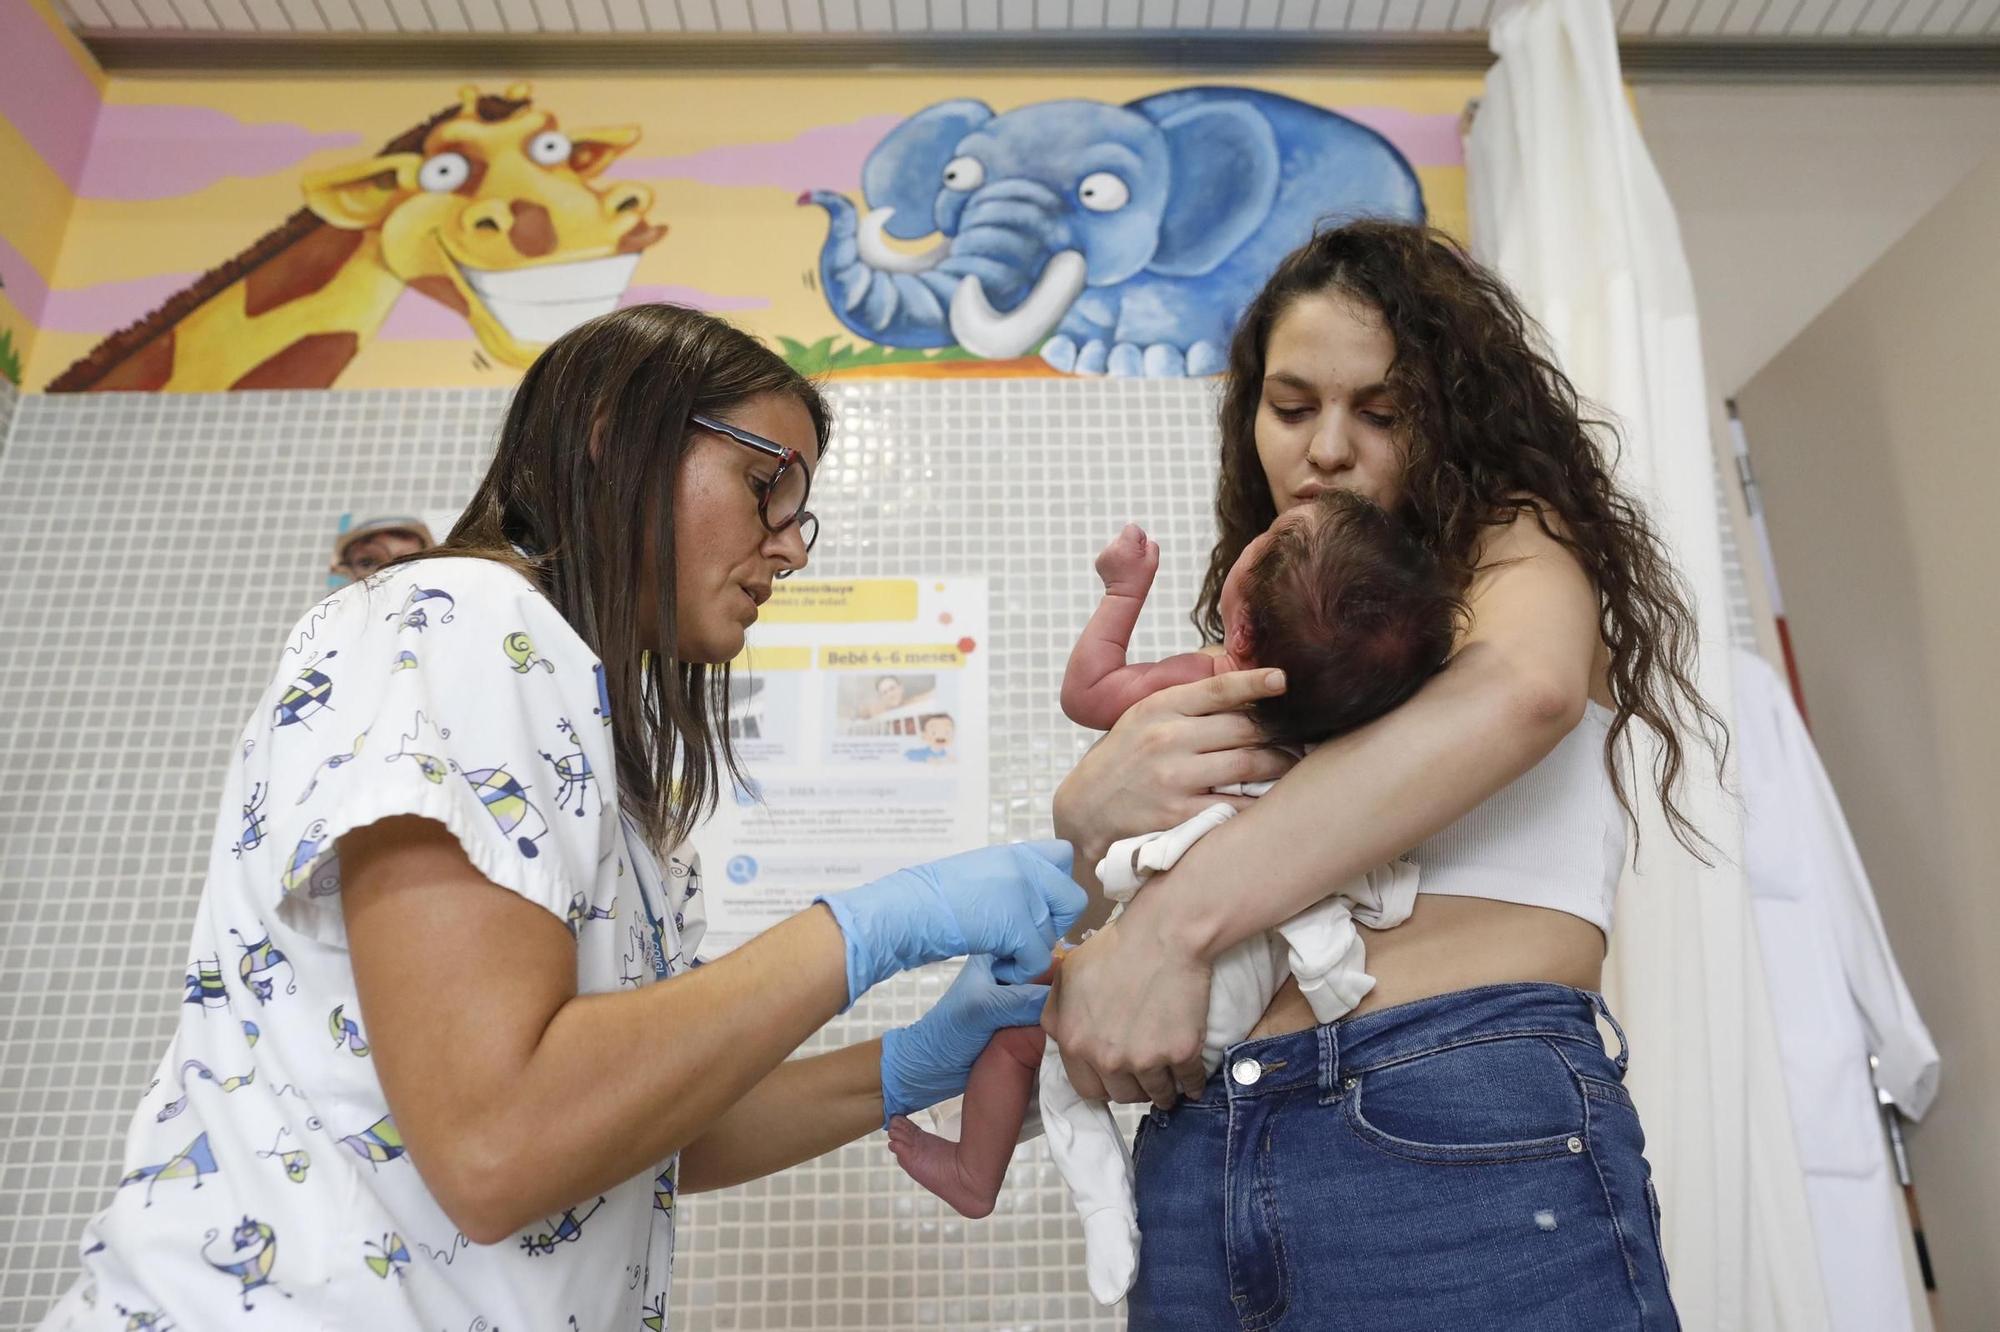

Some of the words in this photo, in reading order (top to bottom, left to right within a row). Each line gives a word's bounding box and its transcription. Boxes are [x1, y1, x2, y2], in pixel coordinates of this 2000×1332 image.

[828, 650, 868, 665] Bebé
[872, 650, 901, 664] 4-6
[905, 653, 958, 664] meses
